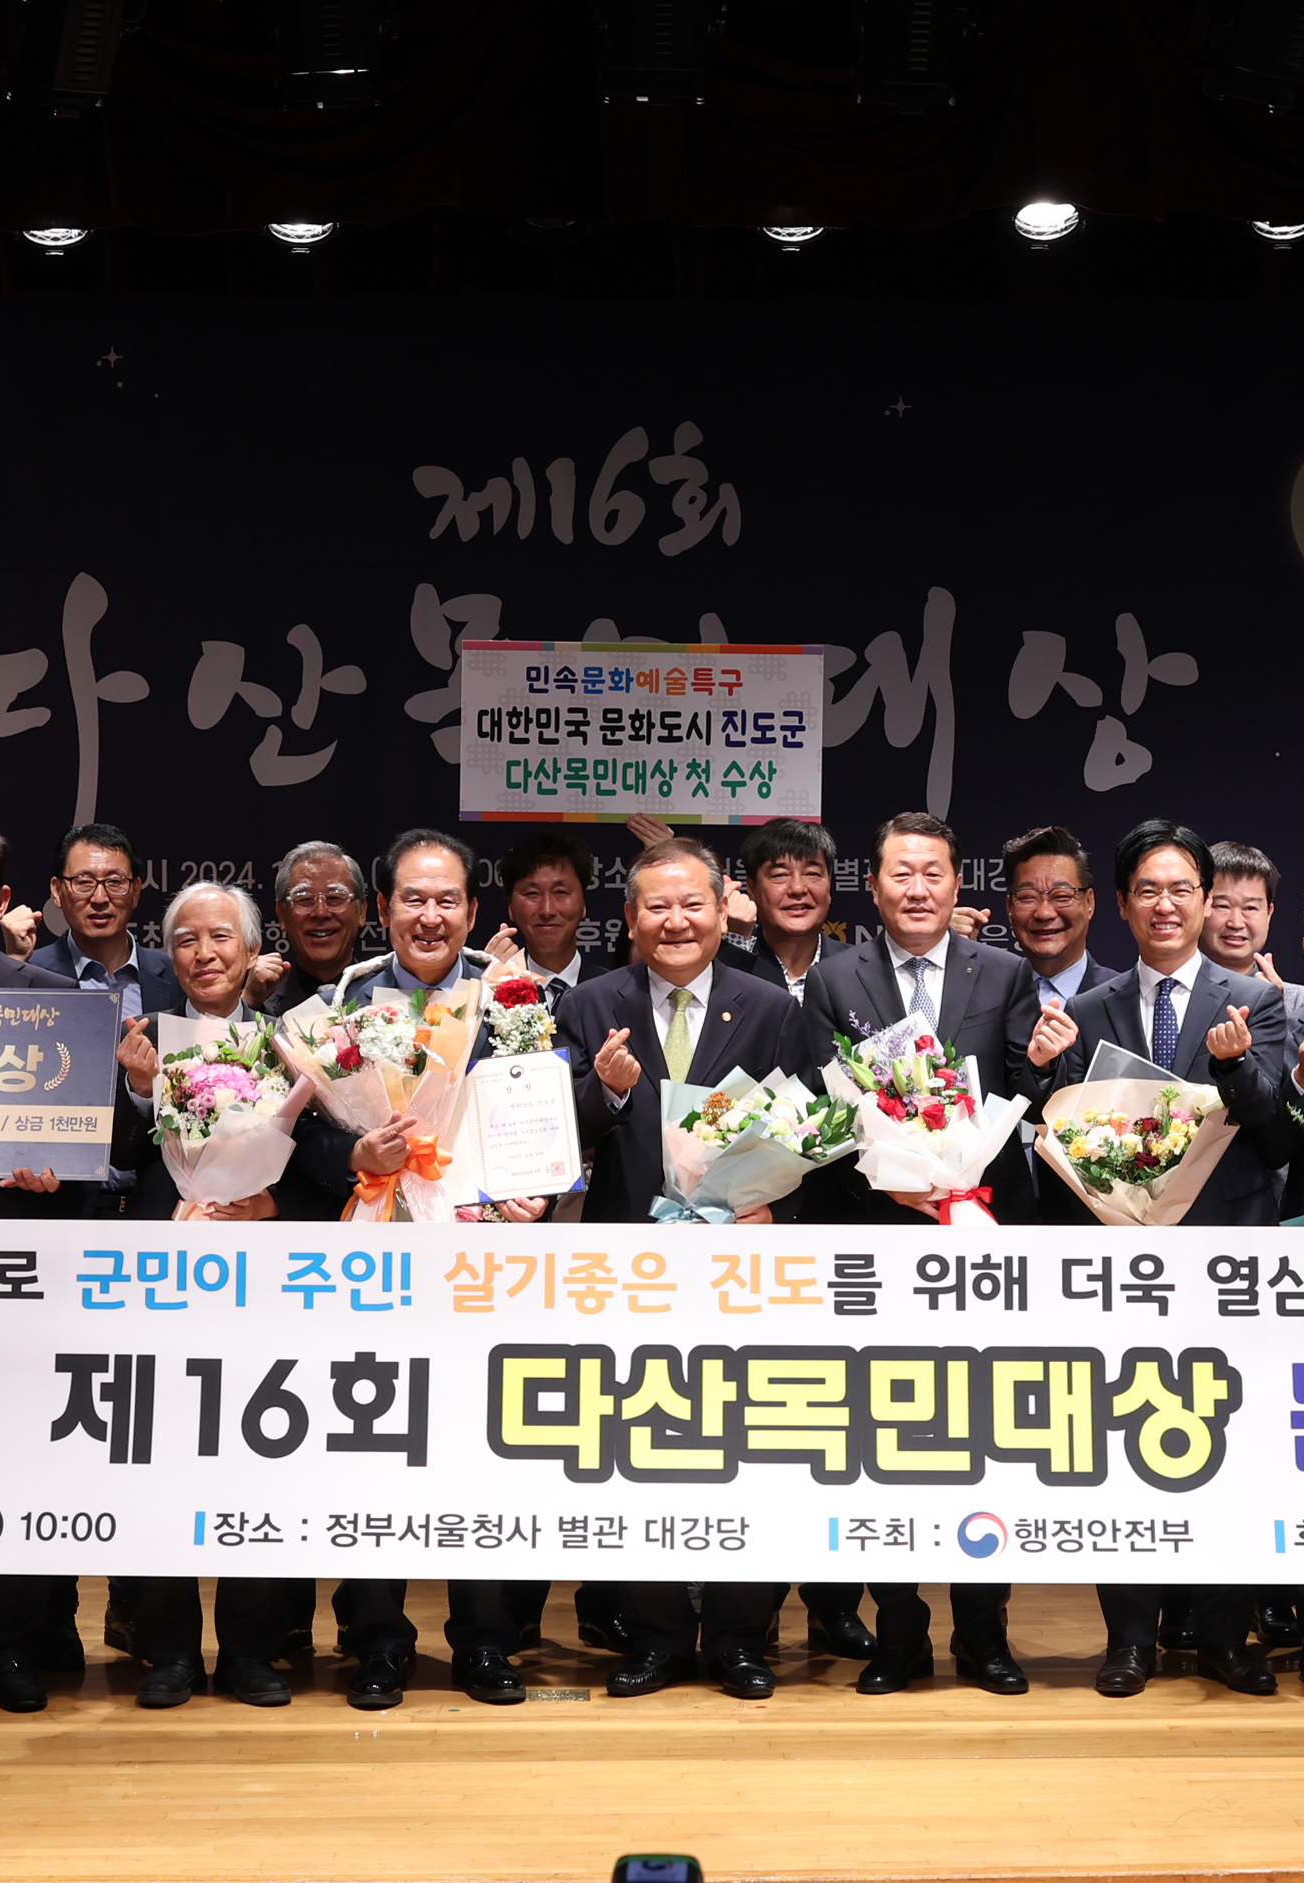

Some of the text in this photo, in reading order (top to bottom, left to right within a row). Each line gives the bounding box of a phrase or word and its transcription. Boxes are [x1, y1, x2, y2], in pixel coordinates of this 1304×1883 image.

[412, 420, 742, 557] 제16회
[526, 665, 743, 696] 민속문화예술특구
[477, 706, 806, 748] 대한민국 문화도시 진도군
[506, 757, 777, 798] 다산목민대상 첫 수상
[180, 860, 263, 890] 2024.
[15, 1116, 44, 1131] 상금
[50, 1116, 97, 1132] 1천만원
[77, 1251, 246, 1310] 군민이
[282, 1251, 411, 1311] 주인!
[444, 1252, 676, 1314] 살기좋은
[712, 1254, 882, 1315] 진도를
[913, 1253, 1027, 1311] 위해
[1062, 1254, 1175, 1316] 더욱
[50, 1352, 429, 1467] 제16회
[487, 1344, 1243, 1493] 다산목민대상
[21, 1512, 116, 1542] 10:00
[214, 1512, 283, 1546] 장소
[326, 1513, 541, 1548] 정부서울청사
[559, 1516, 627, 1548] 별관
[646, 1516, 749, 1550] 대강당
[846, 1518, 914, 1551] 주최
[1015, 1519, 1193, 1553] 행정안전부
